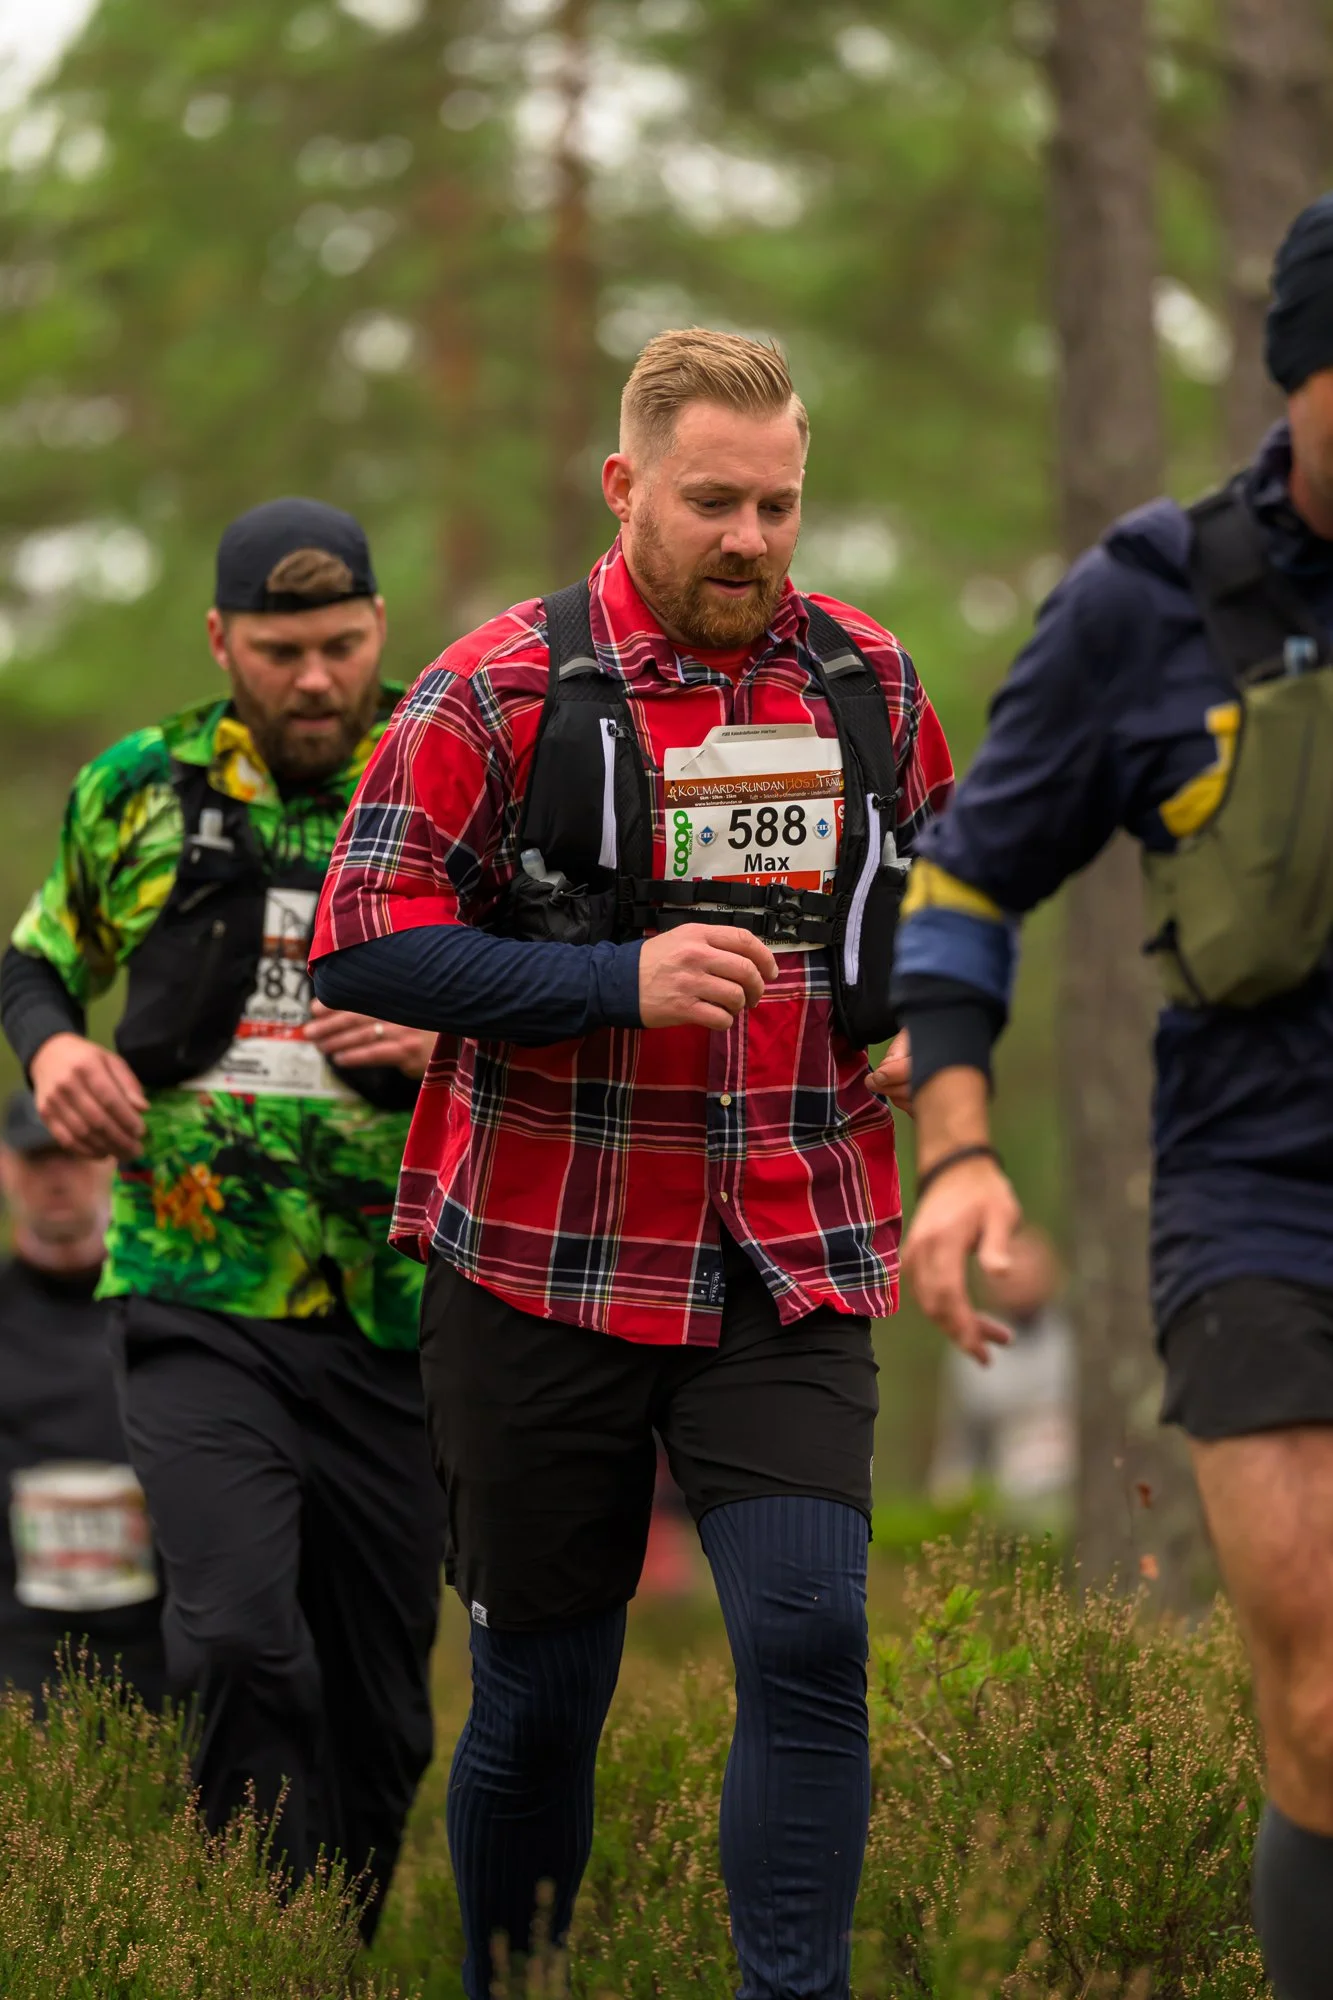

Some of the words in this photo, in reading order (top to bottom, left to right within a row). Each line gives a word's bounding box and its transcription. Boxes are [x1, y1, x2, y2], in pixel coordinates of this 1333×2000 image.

[673, 810, 693, 877] coop
[727, 805, 807, 850] 588
[744, 853, 790, 873] Max
